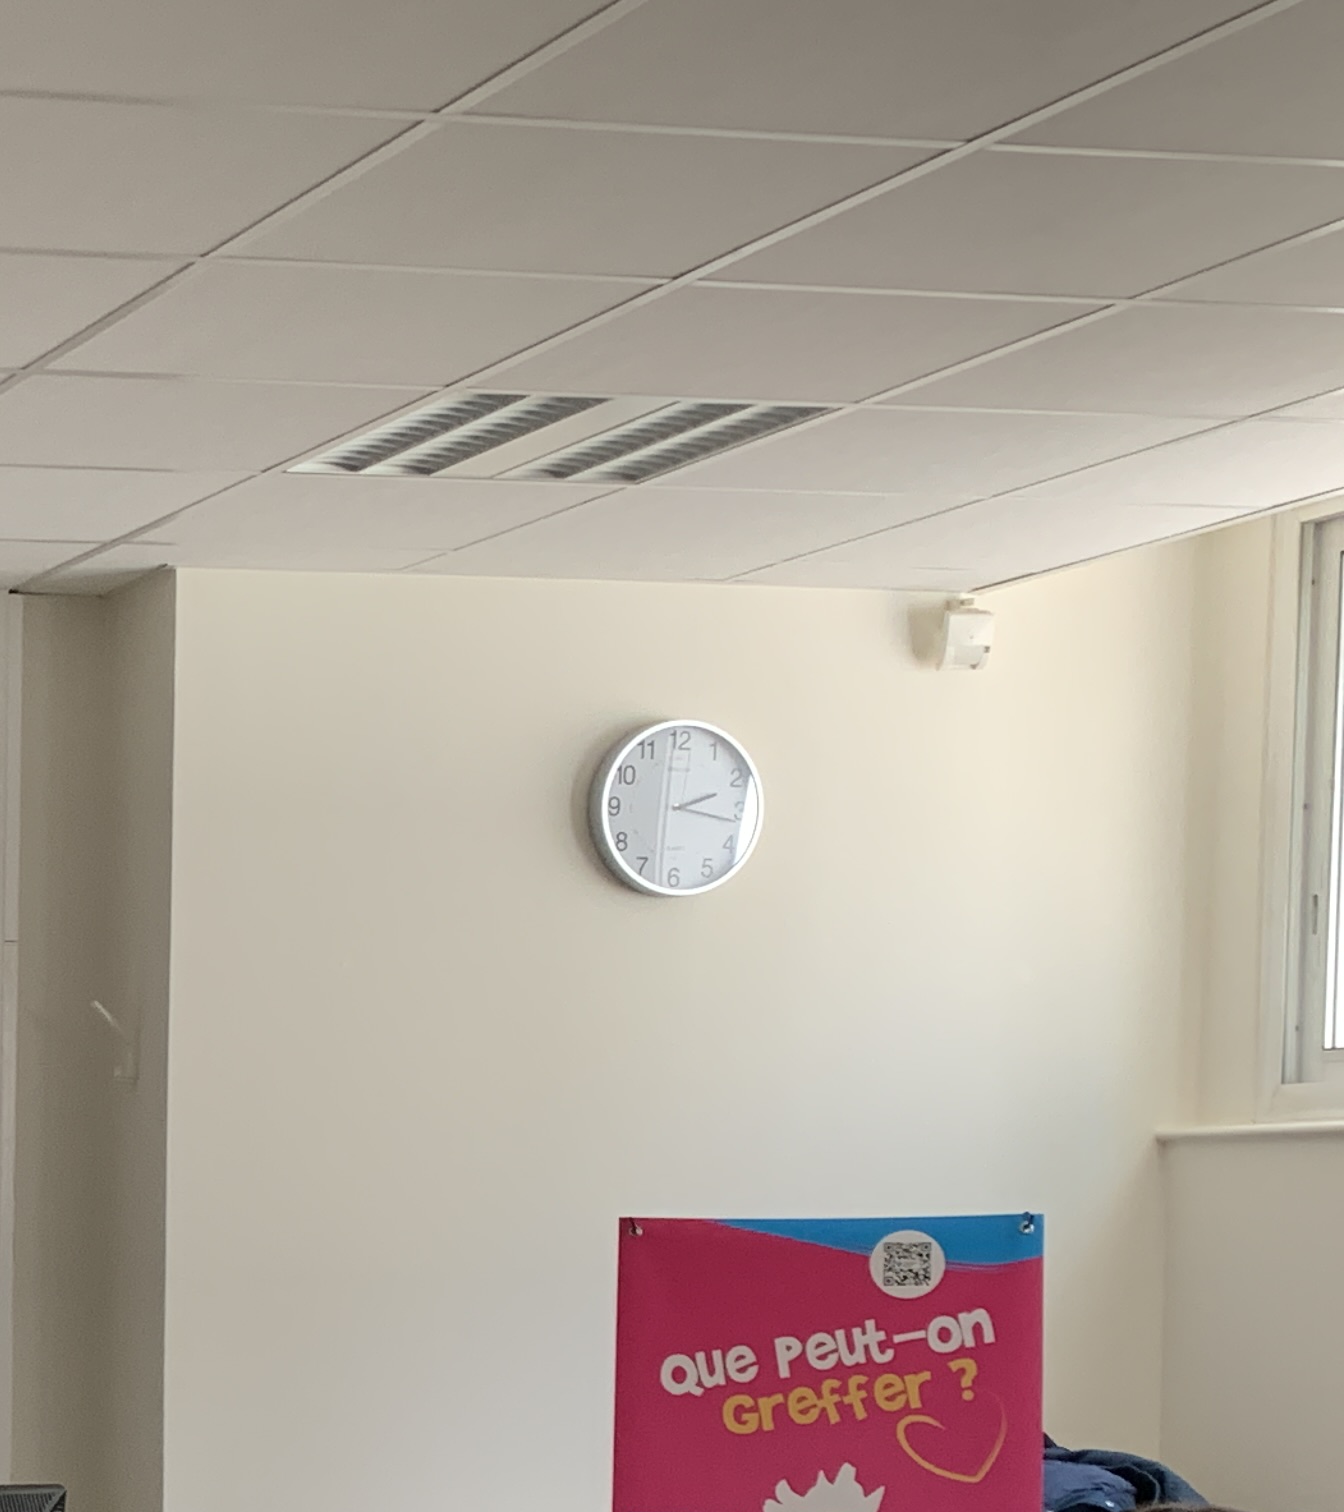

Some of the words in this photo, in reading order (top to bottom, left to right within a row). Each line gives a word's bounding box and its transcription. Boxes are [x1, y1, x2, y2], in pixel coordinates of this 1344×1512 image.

[637, 740, 655, 760] 11
[670, 730, 692, 751] 12
[709, 743, 718, 761] 1
[616, 765, 636, 785] 10
[729, 768, 743, 788] 2
[608, 796, 621, 816] 9
[616, 831, 628, 852] 8
[722, 834, 735, 854] 4
[636, 856, 649, 876] 7
[701, 858, 713, 878] 5
[667, 867, 680, 887] 6
[660, 1345, 759, 1396] Que
[722, 1371, 932, 1434] Greffer
[948, 1358, 978, 1401] ?
